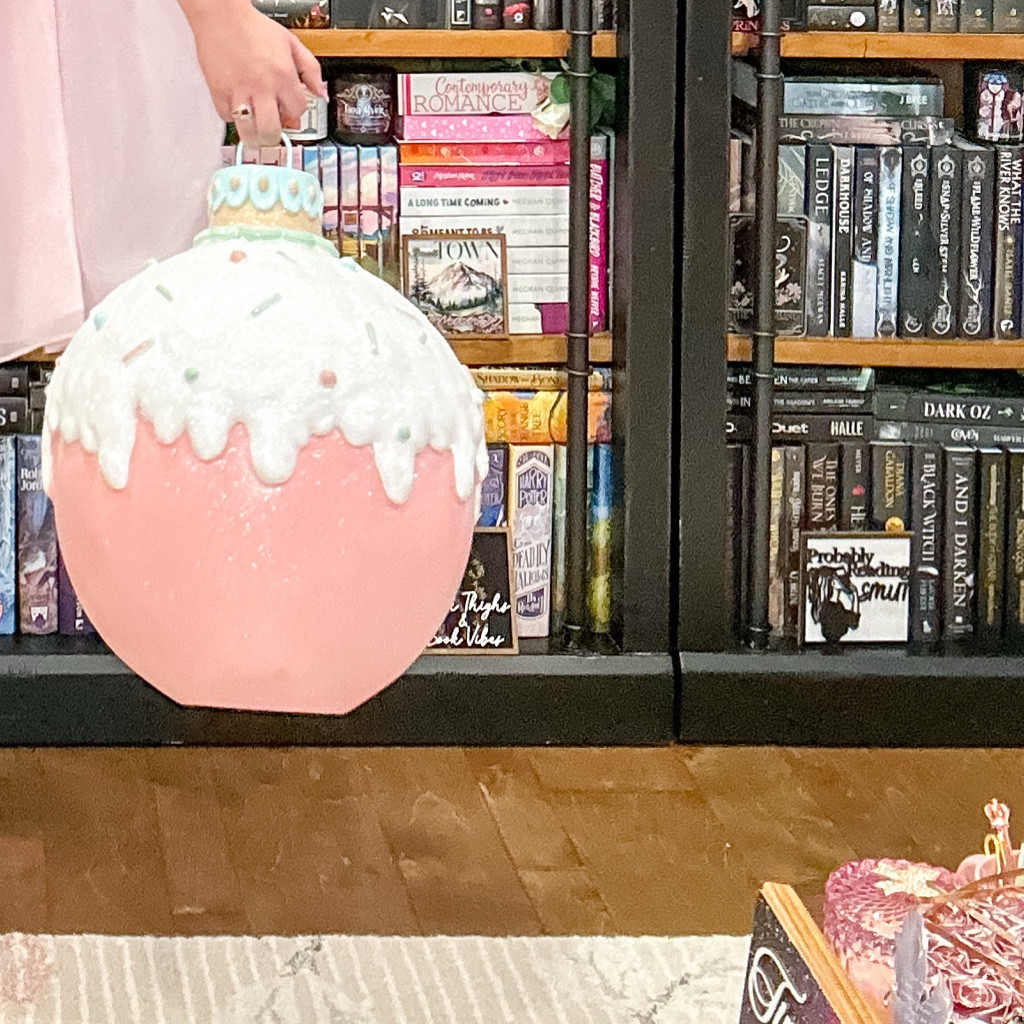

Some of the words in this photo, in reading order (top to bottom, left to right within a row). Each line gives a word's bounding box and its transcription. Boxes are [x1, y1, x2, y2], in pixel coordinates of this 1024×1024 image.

[413, 93, 522, 113] ROMANCE
[435, 76, 528, 102] Contemporary
[1000, 152, 1011, 182] RIVER
[1012, 159, 1021, 195] WHAT
[815, 158, 829, 216] LEDGE
[839, 158, 850, 234] DARKHOUSE
[407, 199, 414, 207] A
[415, 199, 439, 207] LONG
[441, 198, 463, 207] TIME
[464, 198, 501, 207] COMING
[863, 188, 873, 232] SHADOW
[998, 187, 1010, 231] KNOWS
[1011, 202, 1020, 224] THE
[436, 241, 499, 259] TOWN
[477, 373, 520, 385] SHADOW
[924, 402, 966, 419] DARK
[970, 404, 991, 420] OZ
[831, 421, 863, 435] HALLE
[518, 469, 550, 491] HARRY
[812, 455, 826, 480] WE
[826, 460, 837, 482] THE
[885, 450, 896, 509] GABALDON
[895, 462, 905, 496] DIANA
[518, 489, 548, 509] POTTER
[920, 464, 936, 509] BLACK
[955, 473, 969, 513] AND
[812, 484, 825, 522] BURN
[826, 486, 836, 522] ONES
[921, 512, 936, 562] WITCH
[513, 539, 551, 568] DEATHLY
[808, 547, 875, 565] Probably
[953, 533, 967, 607] DARKEN
[461, 590, 511, 620] Thighs
[458, 614, 468, 627] &
[466, 625, 505, 647] Vibes
